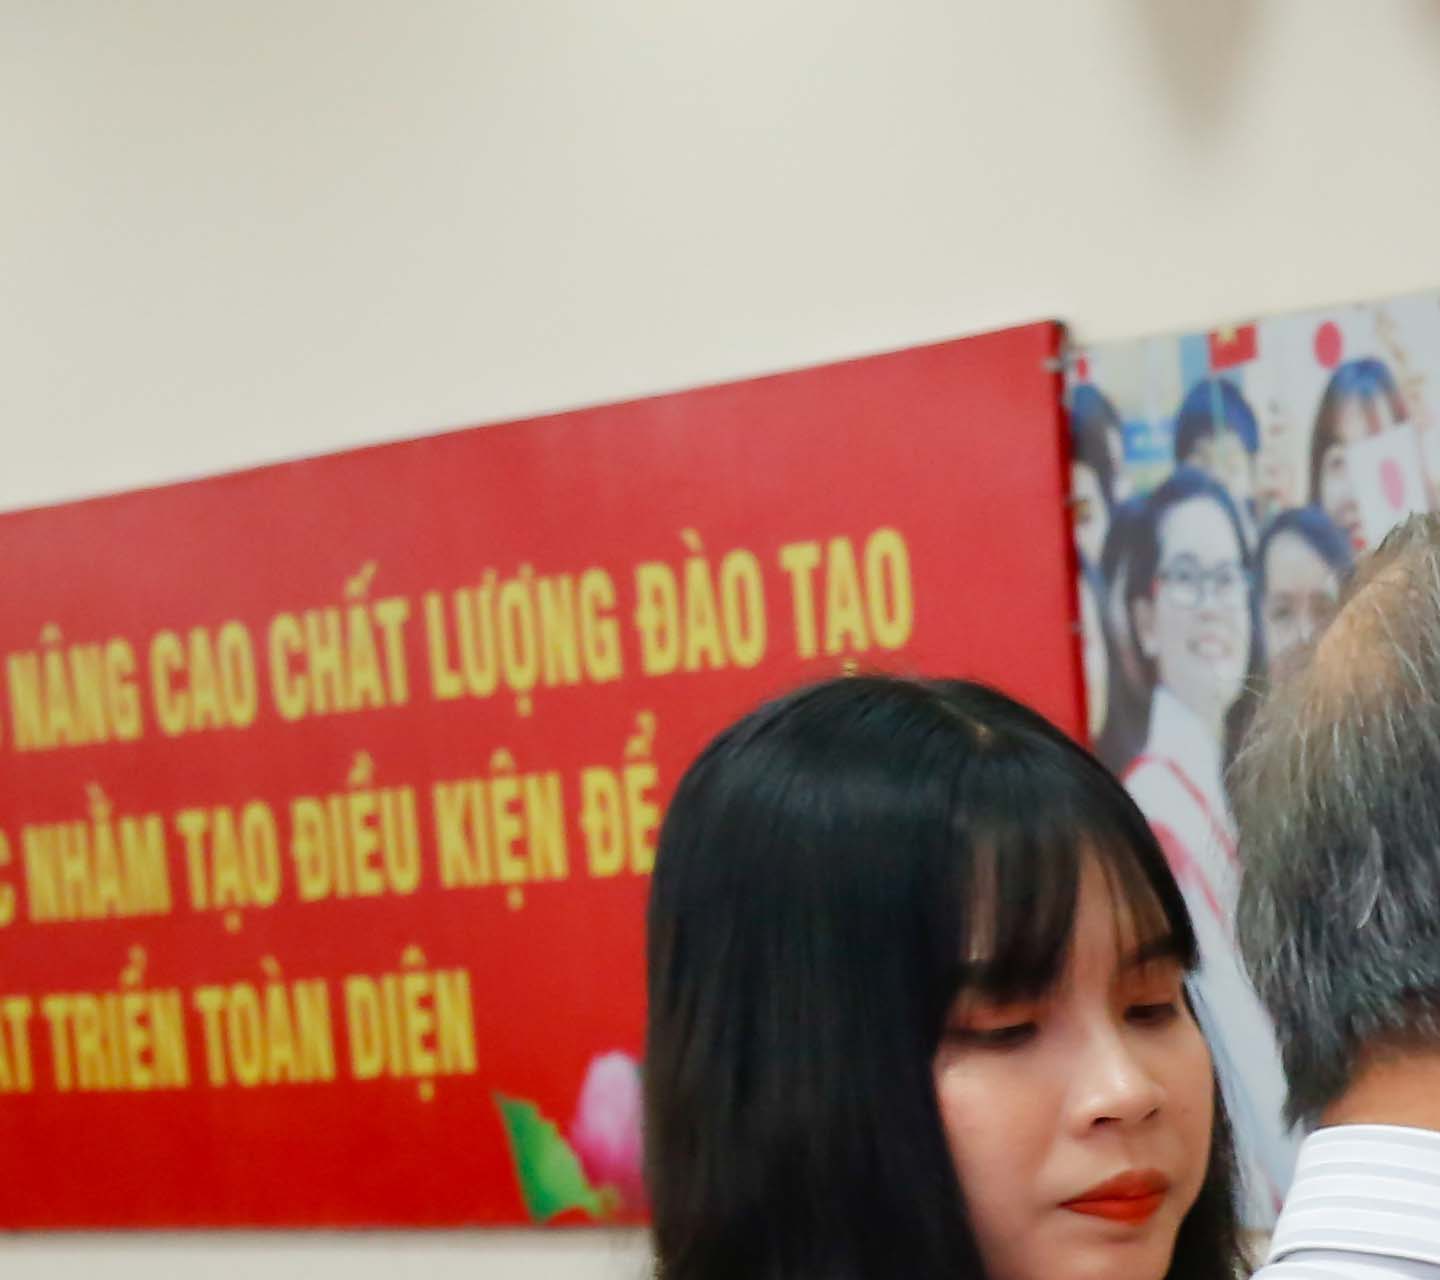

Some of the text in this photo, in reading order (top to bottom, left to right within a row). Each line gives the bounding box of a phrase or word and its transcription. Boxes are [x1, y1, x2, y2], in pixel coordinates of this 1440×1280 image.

[6, 527, 913, 752] NÂNG CAO CHẤT LƯỢNG ĐÀO TẠO
[175, 799, 282, 934] TẠO
[433, 747, 568, 911] KIỆN
[580, 710, 659, 879] ĐỂ
[42, 945, 190, 1091] TRIỂN
[194, 954, 336, 1086] TOÀN
[343, 944, 478, 1101] DIỆN
